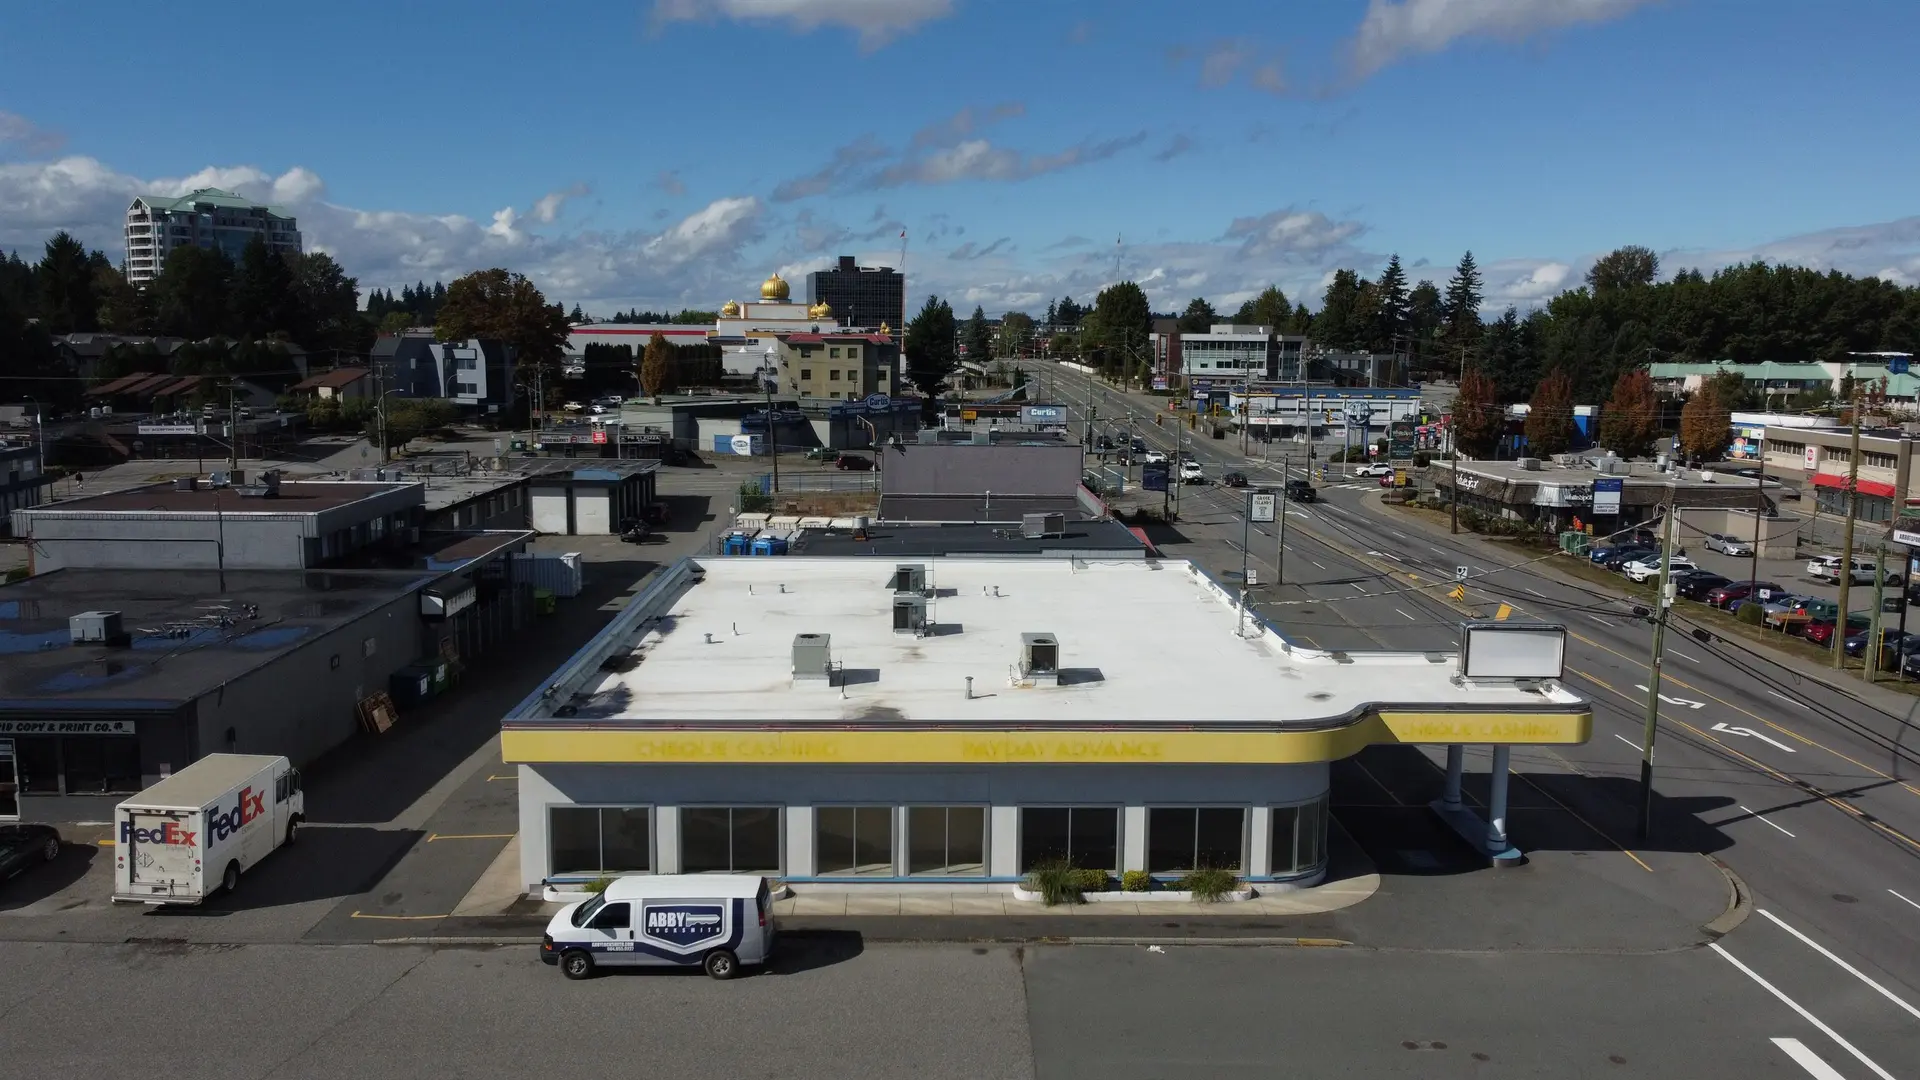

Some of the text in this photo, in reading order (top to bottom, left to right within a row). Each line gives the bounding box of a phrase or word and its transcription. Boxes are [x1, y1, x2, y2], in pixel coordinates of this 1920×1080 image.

[869, 396, 888, 406] Curtis
[1031, 408, 1056, 416] Curtis
[0, 722, 112, 732] ID COPY & PRINT CO.
[963, 741, 1163, 757] PAYDAY ADVANCE
[207, 785, 265, 849] FedEx
[121, 821, 197, 847] FedEx
[648, 912, 686, 928] ABBY
